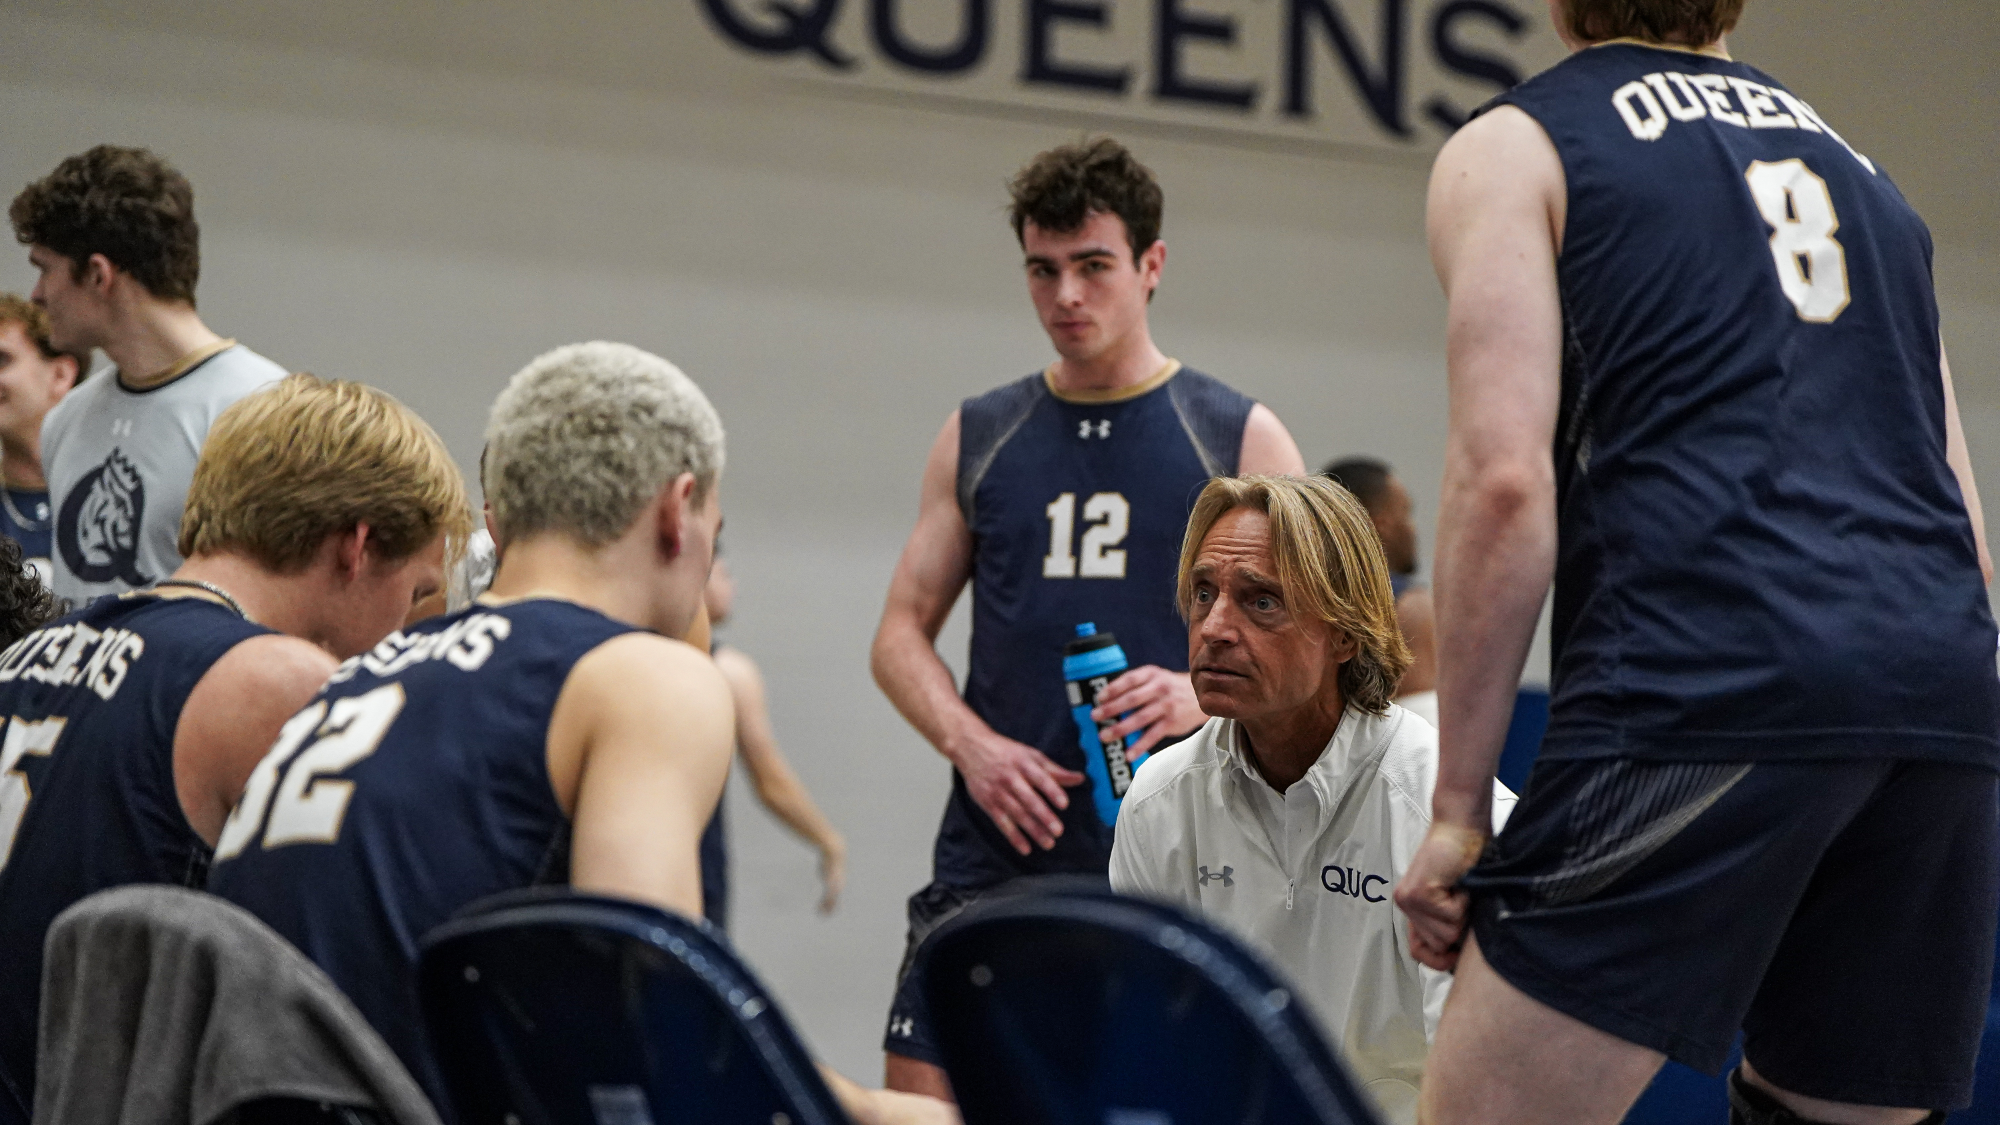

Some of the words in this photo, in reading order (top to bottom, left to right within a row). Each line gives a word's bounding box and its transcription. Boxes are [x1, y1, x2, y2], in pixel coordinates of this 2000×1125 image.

[1611, 71, 1877, 176] QUEEN
[1744, 158, 1851, 324] 8
[1042, 492, 1130, 579] 12
[1321, 865, 1389, 903] QUC
